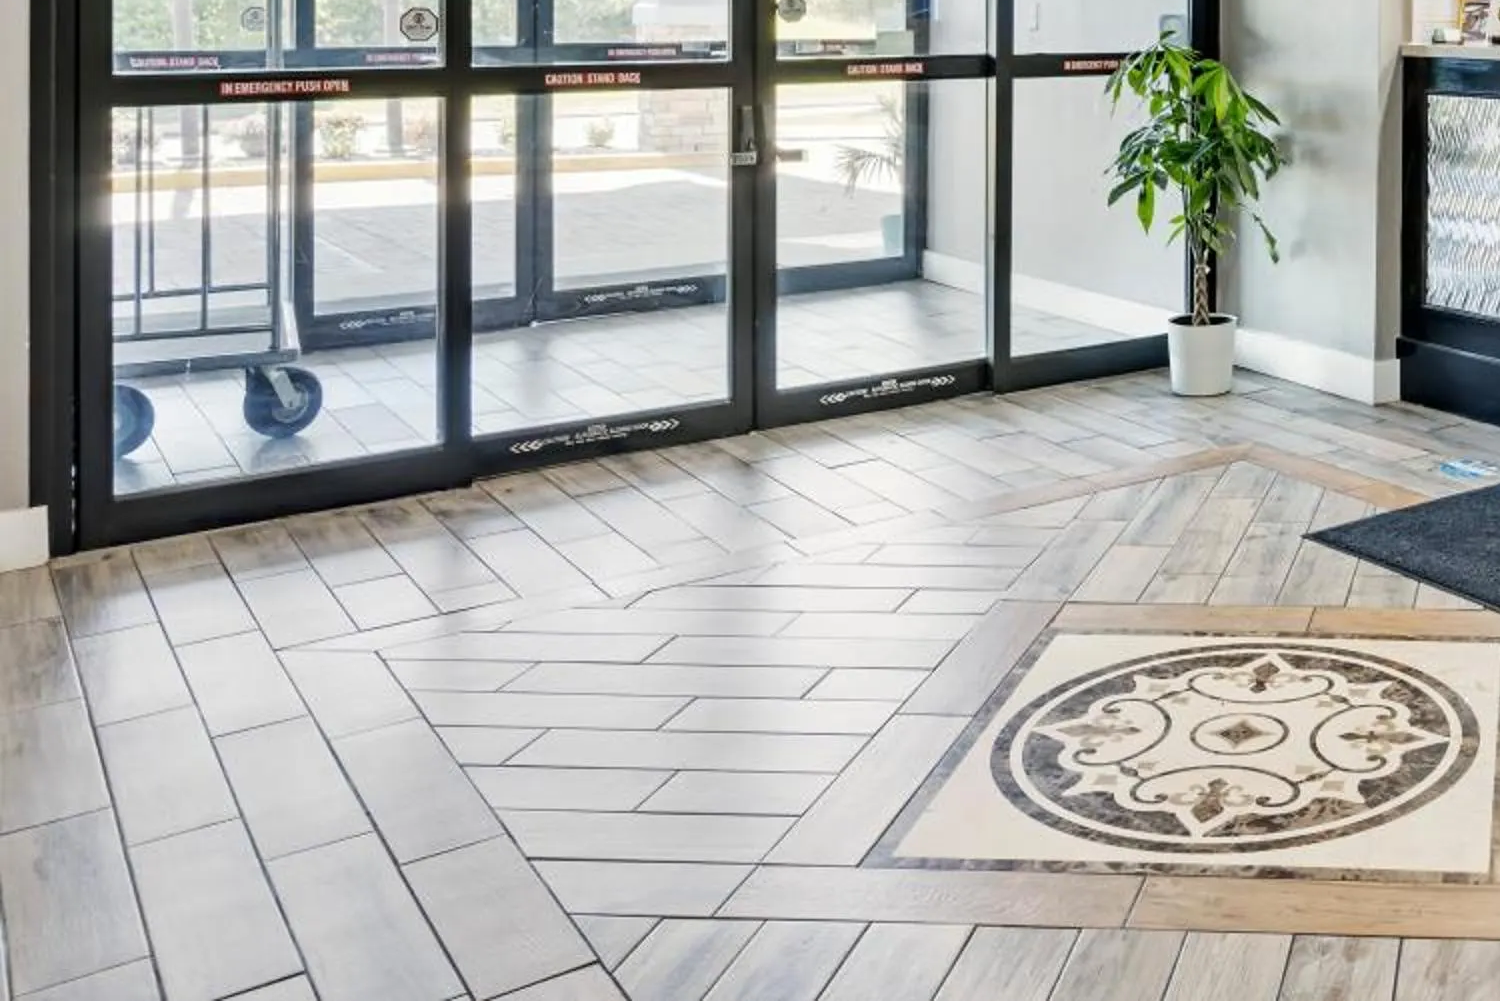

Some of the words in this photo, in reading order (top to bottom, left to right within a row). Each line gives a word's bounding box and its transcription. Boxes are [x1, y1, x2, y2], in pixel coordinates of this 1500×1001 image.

[545, 74, 582, 85] CAUTION
[617, 72, 640, 84] BACK
[221, 82, 233, 95] IN
[235, 81, 293, 95] EMERGENCY
[295, 80, 321, 93] PUSH
[323, 79, 349, 92] OPEN
